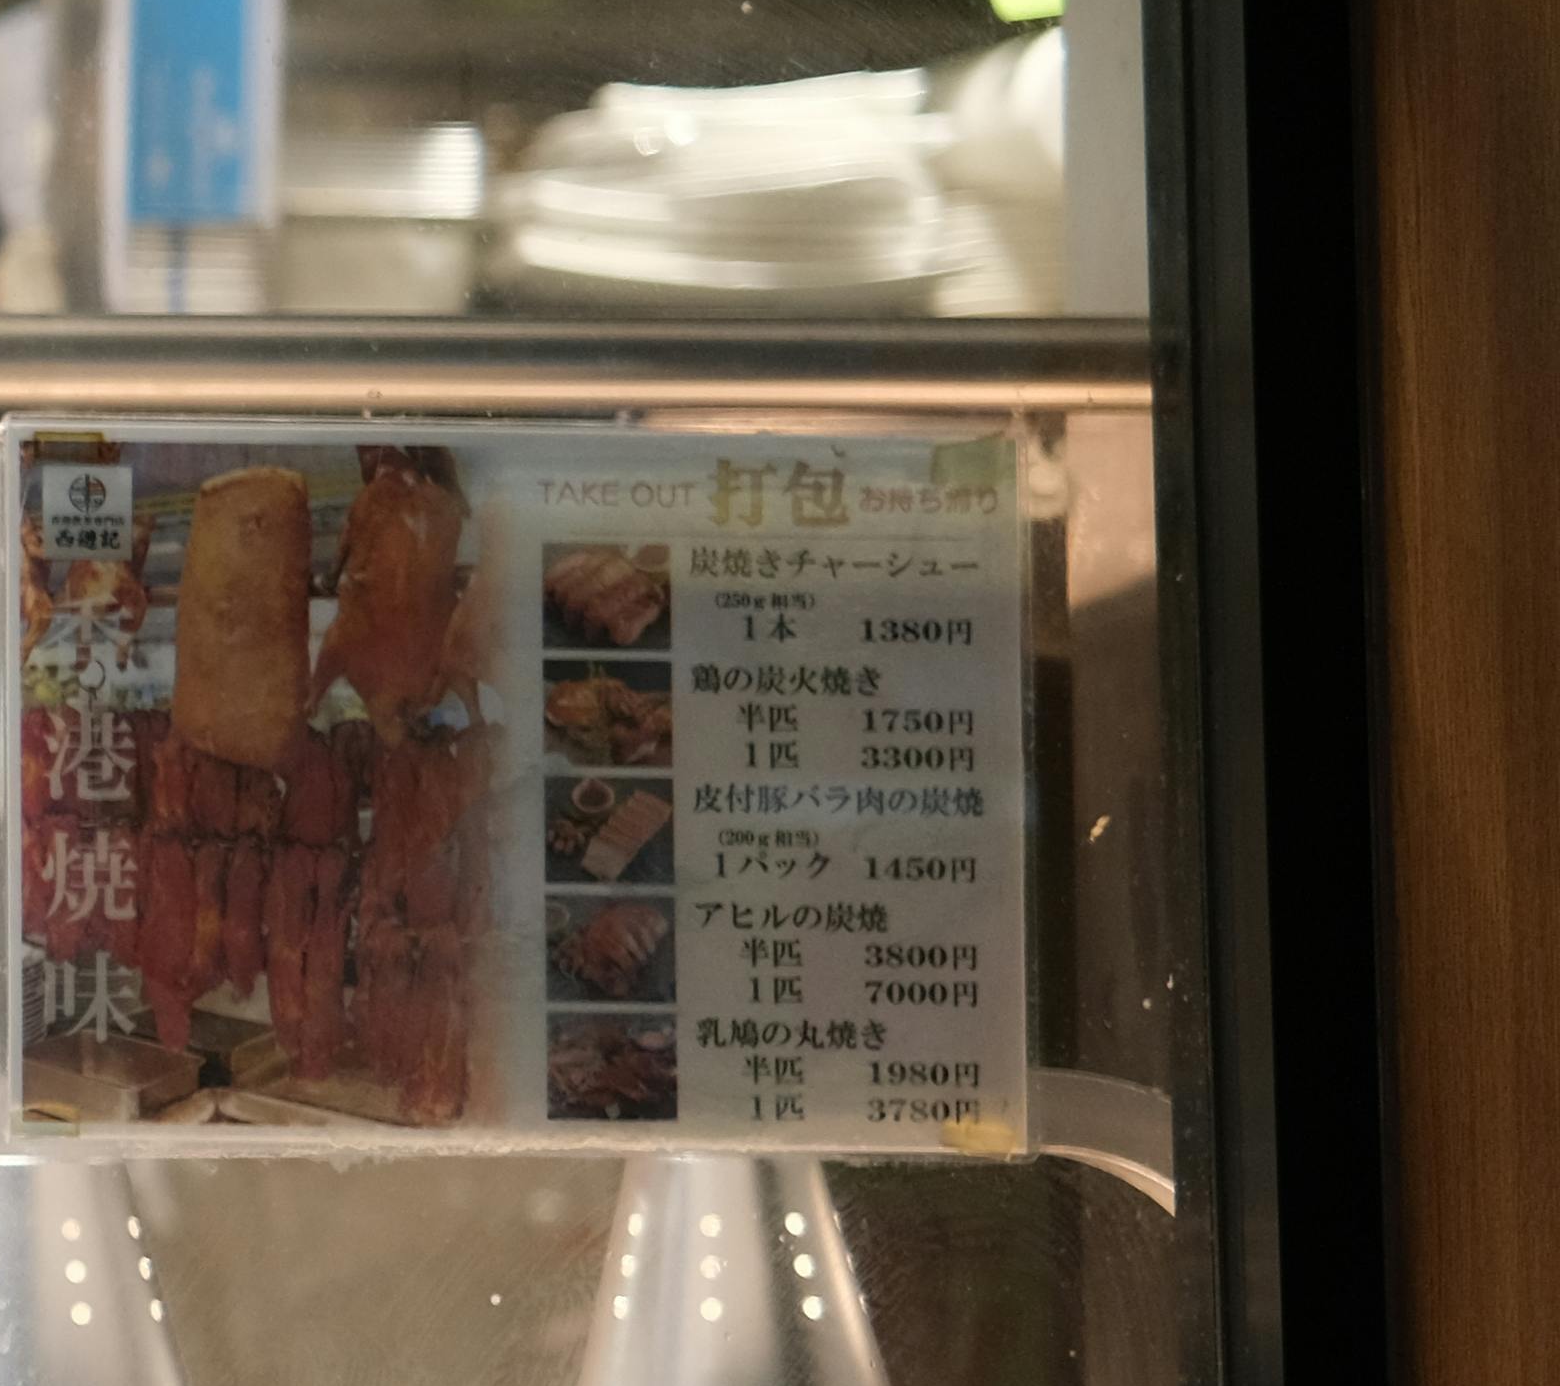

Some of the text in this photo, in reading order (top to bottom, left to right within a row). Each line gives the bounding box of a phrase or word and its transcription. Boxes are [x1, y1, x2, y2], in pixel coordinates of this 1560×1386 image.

[538, 481, 696, 507] TAKE OUT
[707, 458, 850, 528] 打包
[859, 486, 1000, 513] お持ち帰り
[689, 549, 980, 579] 炭焼きチャーシュー
[743, 615, 973, 646] 1本 1380円
[691, 664, 883, 696] 鶏の炭火焼き
[736, 704, 974, 736] 半匹 1750円
[744, 741, 975, 773] 1匹 3300円
[693, 784, 984, 817] 皮付豚バラ肉の炭焼
[714, 852, 976, 884] 1パック 1450円
[694, 901, 889, 934] アヒルの炭焼
[740, 938, 978, 972] 半匹 3800円
[748, 976, 979, 1009] 1匹 7000円
[696, 1018, 889, 1051] 乳鳩の丸焼き
[743, 1056, 981, 1089] 半匹 1980円
[750, 1093, 981, 1125] 1匹 3780円
